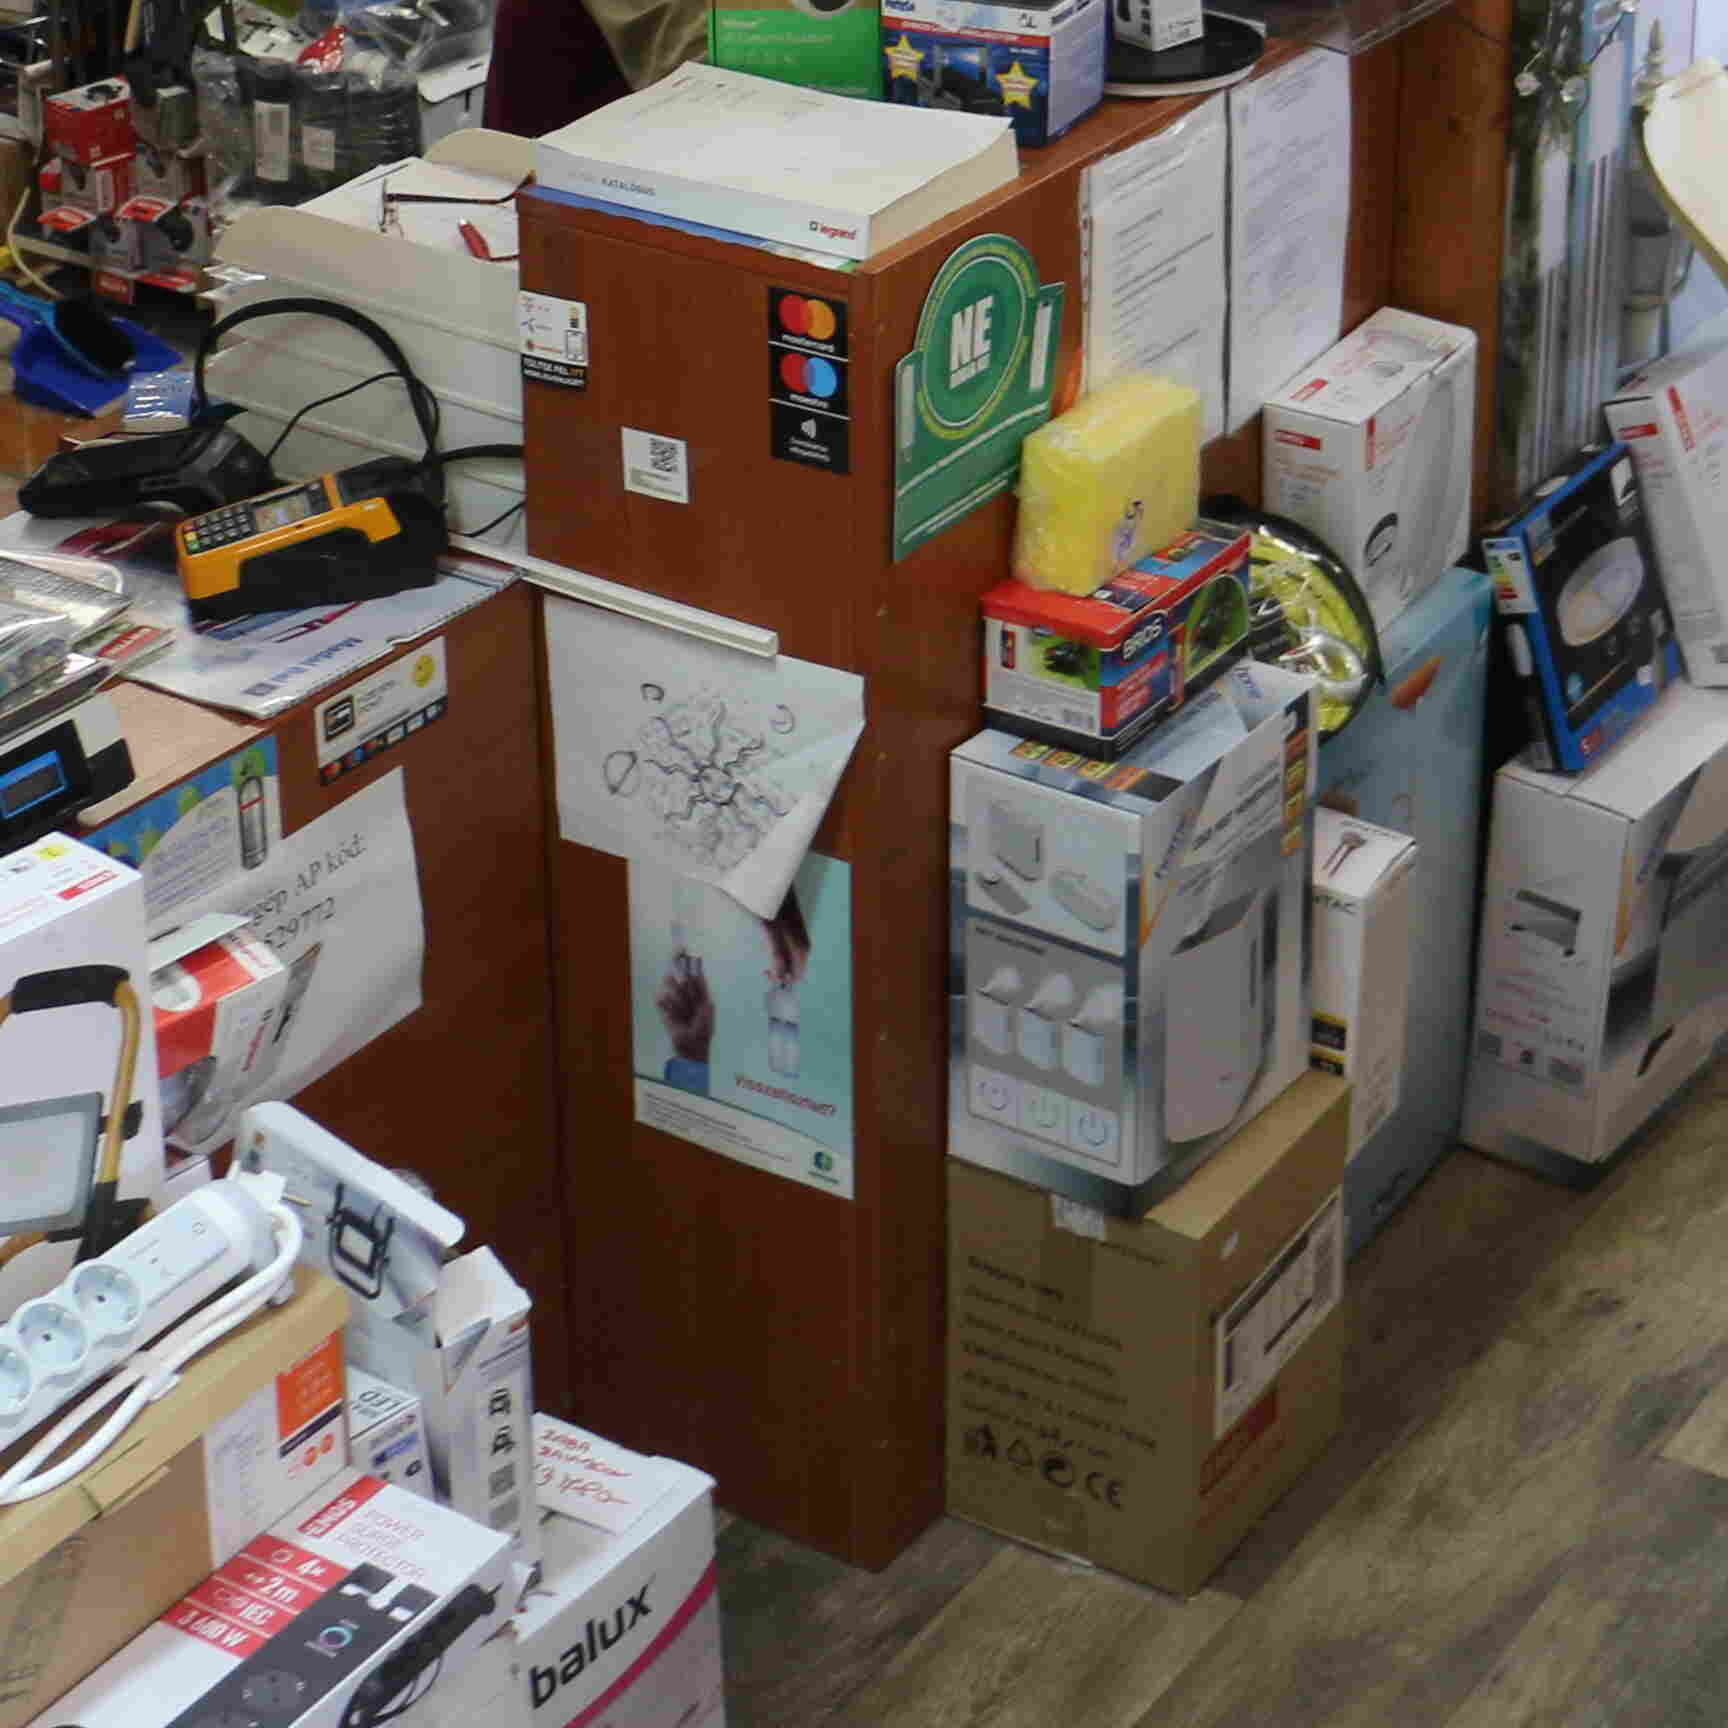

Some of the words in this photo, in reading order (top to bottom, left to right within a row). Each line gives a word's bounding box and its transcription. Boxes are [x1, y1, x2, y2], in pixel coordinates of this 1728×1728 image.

[819, 223, 856, 241] legrand
[1121, 614, 1166, 660] BROS
[529, 1583, 656, 1710] balux
